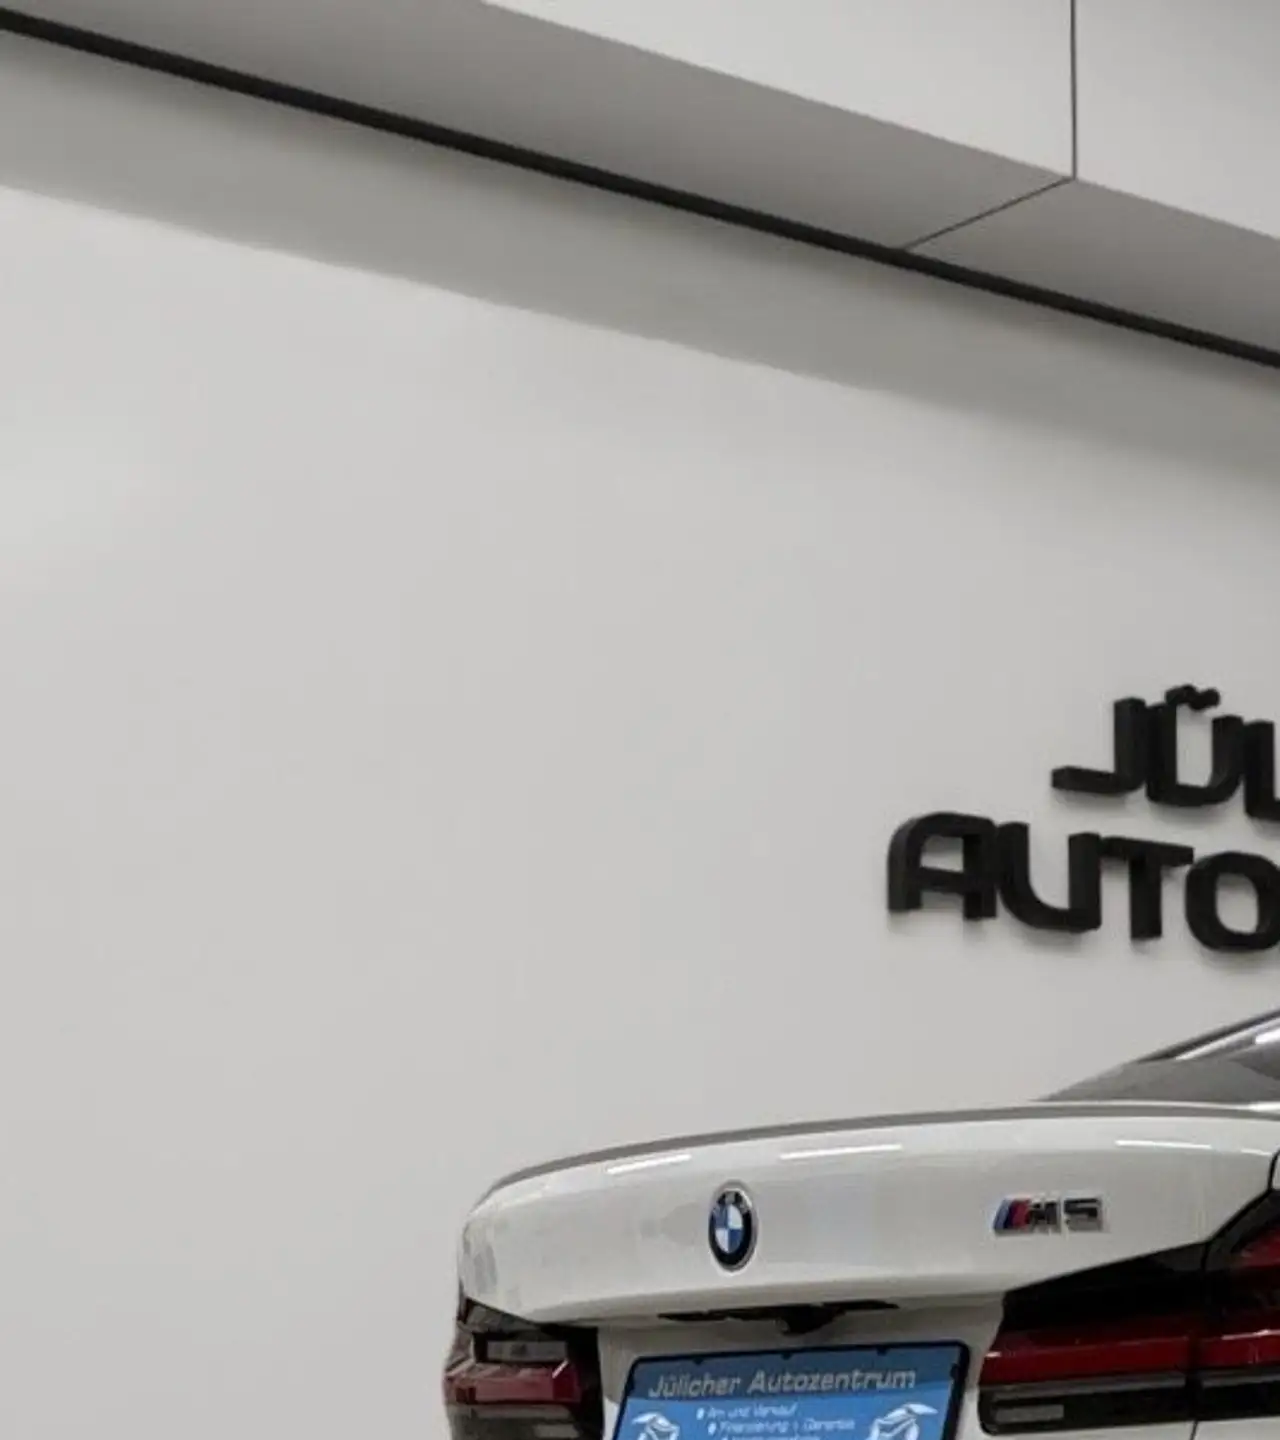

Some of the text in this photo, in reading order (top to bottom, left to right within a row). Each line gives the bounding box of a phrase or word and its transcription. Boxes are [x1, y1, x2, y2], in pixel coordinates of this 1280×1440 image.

[1024, 1195, 1103, 1233] M5
[648, 1368, 917, 1398] Jülicher Autozentrum
